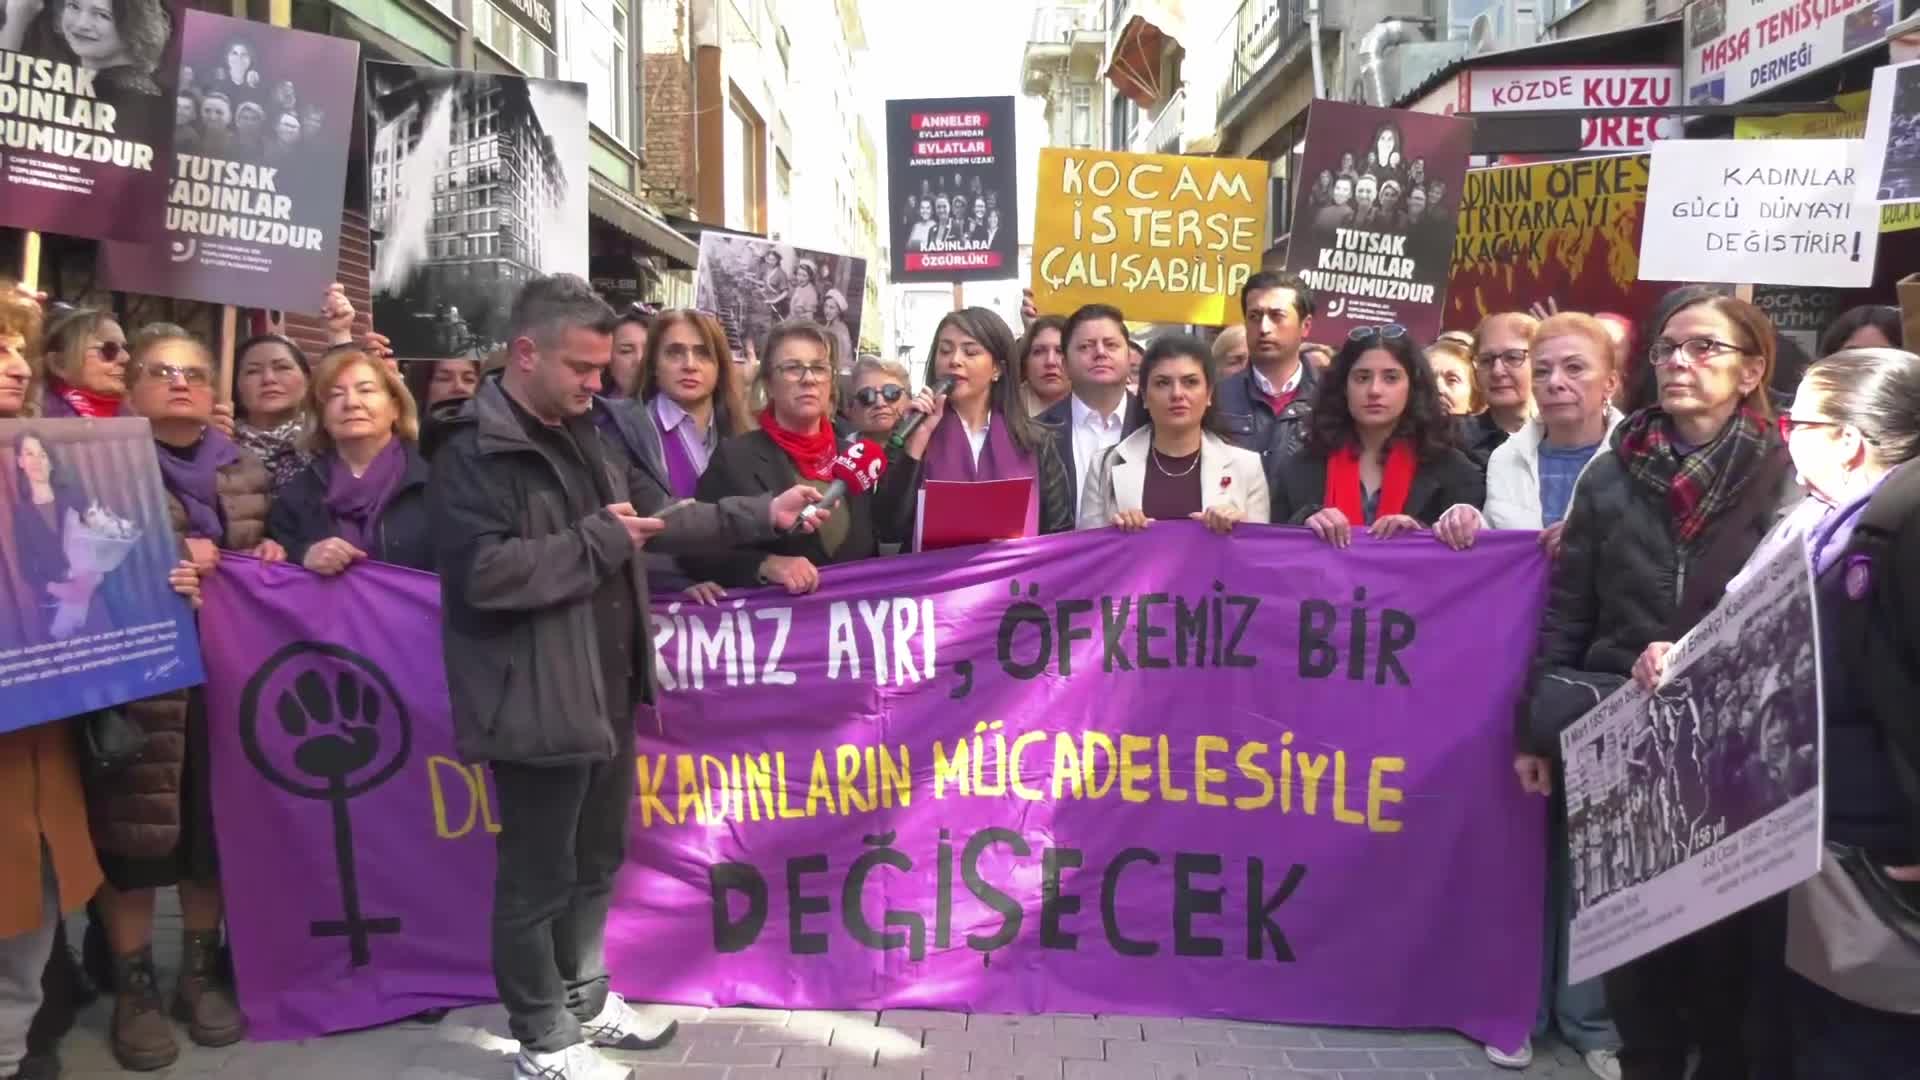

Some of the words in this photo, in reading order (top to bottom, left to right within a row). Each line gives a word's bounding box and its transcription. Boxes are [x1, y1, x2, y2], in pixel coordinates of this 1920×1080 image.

[1701, 27, 1751, 74] MASA
[1750, 43, 1812, 89] DERNEĞİ
[1492, 76, 1573, 107] KÖZDE
[1584, 77, 1671, 106] KUZU
[920, 114, 982, 128] ANNELER
[918, 141, 985, 154] EVLATLAR
[177, 153, 278, 192] TUTSAK
[1062, 157, 1252, 203] KOCAM
[1463, 167, 1532, 206] DININ
[1723, 167, 1856, 187] KADINLAR
[1672, 196, 1739, 219] GÜCÜ
[1759, 195, 1851, 220] DÜNYAYI
[1073, 199, 1257, 252] İSTERSE
[1336, 228, 1407, 256] TUTSAK
[920, 240, 989, 253] KADINLARA
[921, 252, 989, 267] ÖZGÜRLÜK!
[1318, 248, 1415, 279] KADINLAR
[996, 579, 1261, 681] ÖFKEMİZ
[1299, 586, 1417, 686] BİR
[636, 741, 911, 828] KADINLARIN
[933, 720, 1406, 833] MÜCADELESİYLE
[709, 826, 1308, 969] DEĞİŞECEK
